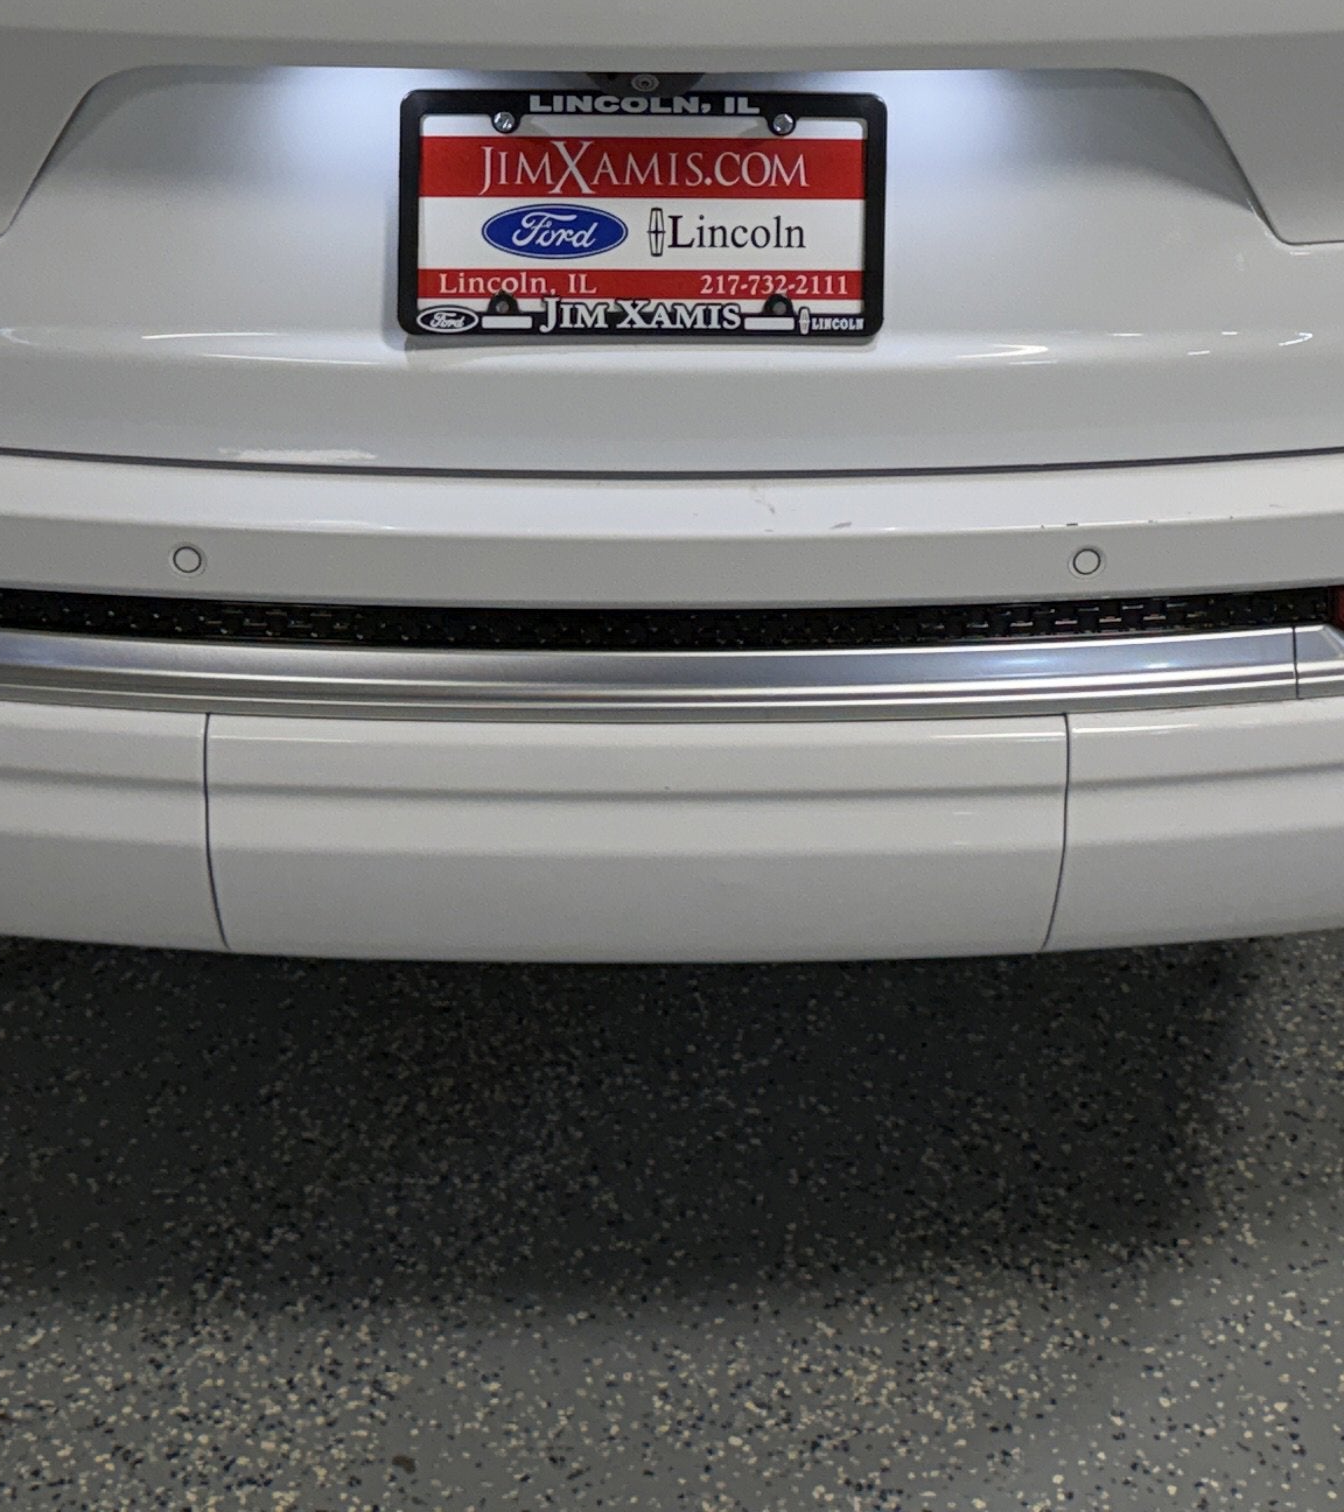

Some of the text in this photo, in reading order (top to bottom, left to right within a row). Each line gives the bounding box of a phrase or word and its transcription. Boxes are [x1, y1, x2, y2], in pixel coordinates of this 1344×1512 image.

[529, 94, 760, 115] LINCOLN, IL
[479, 140, 809, 195] JIMXAMIS.COM
[511, 210, 600, 250] Ford
[668, 215, 806, 250] Lincoln
[568, 273, 597, 294] IL
[700, 274, 848, 297] 217-732-2111
[430, 311, 466, 329] Ford
[539, 296, 741, 333] JIM XAMIS
[811, 317, 864, 331] LINCOLN
